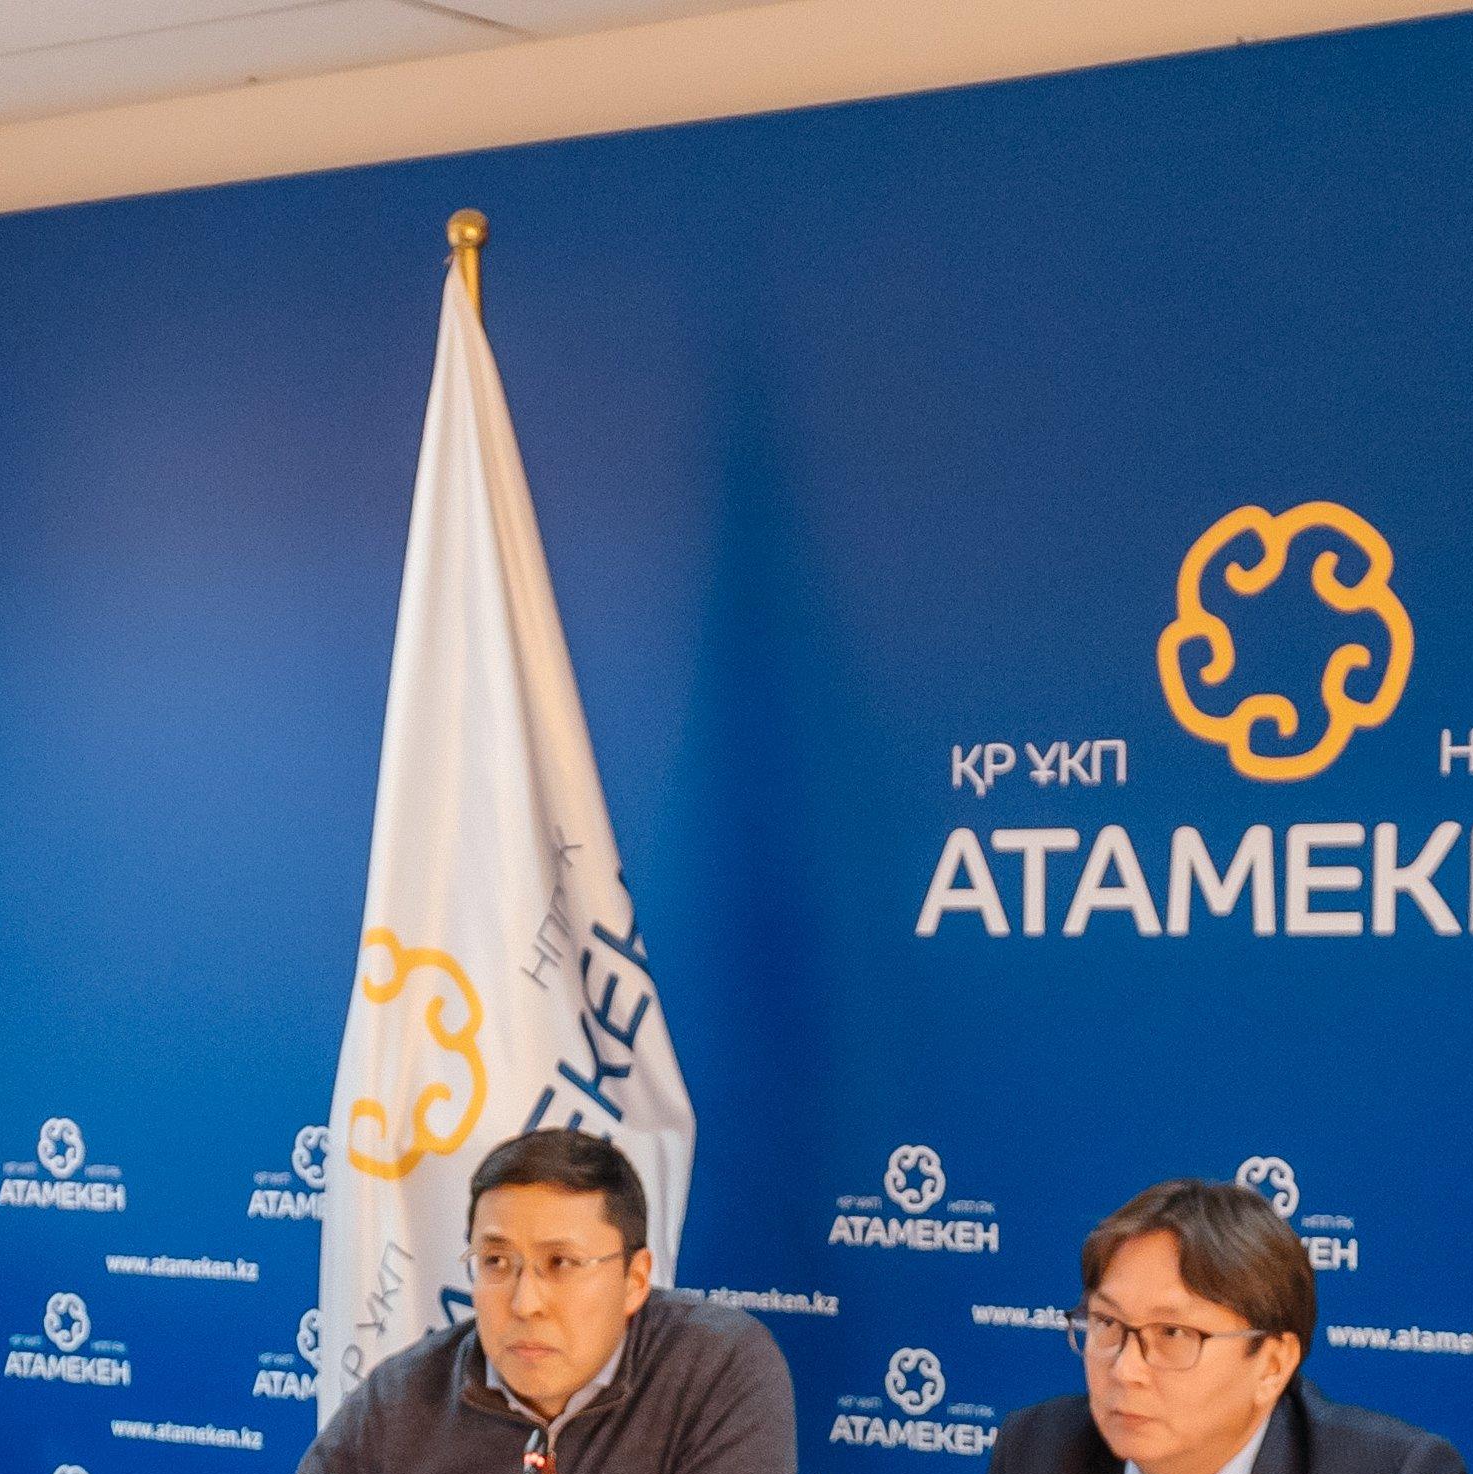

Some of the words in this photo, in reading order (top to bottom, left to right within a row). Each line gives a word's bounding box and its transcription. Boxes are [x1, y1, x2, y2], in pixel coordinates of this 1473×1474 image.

[828, 1215, 1000, 1253] АТАМЕКЕН
[4, 1350, 132, 1387] АТАМЕКЕН
[829, 1414, 999, 1456] АТАМЕКЕН
